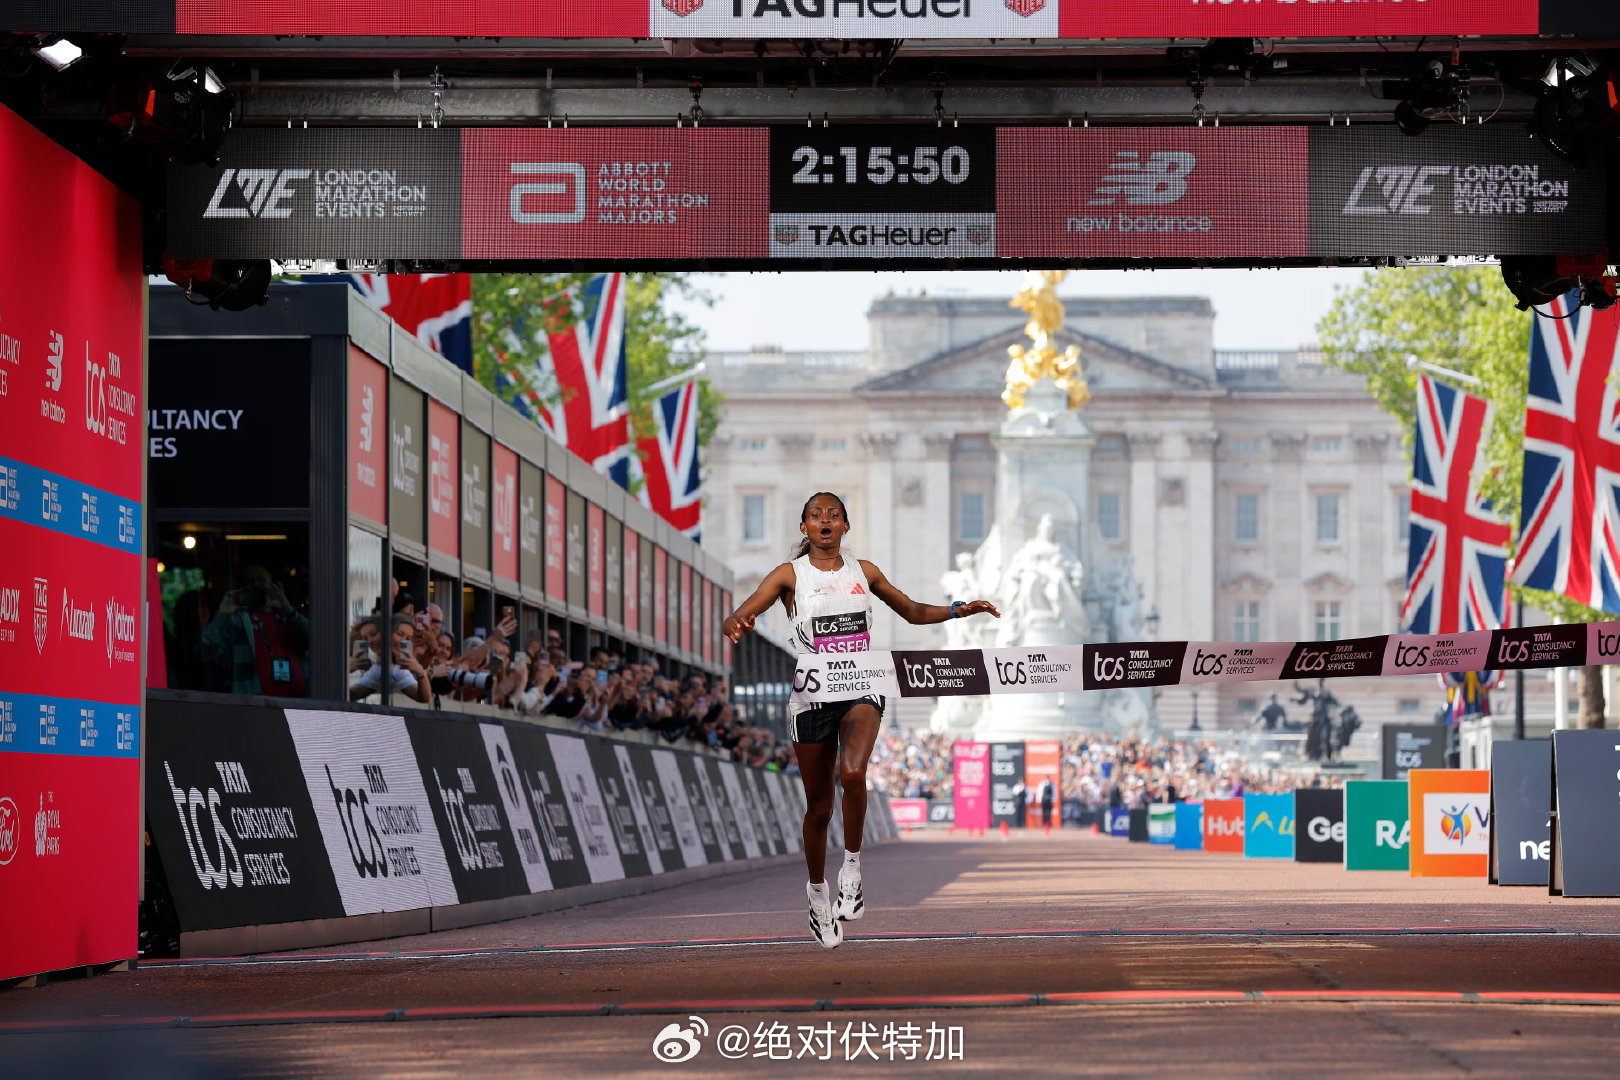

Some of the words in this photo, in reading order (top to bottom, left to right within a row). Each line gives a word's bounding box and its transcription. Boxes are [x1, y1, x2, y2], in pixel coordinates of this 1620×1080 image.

[599, 162, 672, 176] ABBOTT
[792, 146, 970, 184] 2:15:50
[316, 171, 397, 185] LONDON
[1454, 165, 1539, 181] LONDON
[599, 178, 666, 192] WORLD
[1454, 181, 1569, 197] MARATHON
[316, 186, 426, 202] MARATHON
[599, 193, 710, 208] MARATHON
[316, 203, 385, 217] EVENTS
[1454, 198, 1526, 213] EVENTS
[599, 210, 677, 224] MAJORS
[1067, 216, 1113, 232] new
[1118, 212, 1214, 233] balance
[808, 225, 957, 246] TAGHeuer
[109, 352, 121, 379] TATA
[86, 340, 106, 436] tcs
[148, 409, 244, 430] LTANCY
[815, 620, 838, 634] tcs
[1534, 633, 1553, 642] TATA
[1433, 647, 1478, 658] CONSULTANCY
[1498, 635, 1530, 663] tcs
[1533, 641, 1576, 652] CONSULTANCY
[933, 657, 952, 666] TATA
[1028, 654, 1047, 662] TATA
[1130, 650, 1150, 659] TATA
[1193, 648, 1228, 675] tcs
[1229, 657, 1275, 665] CONSULTANCY
[1295, 648, 1330, 672] tcs
[1330, 652, 1374, 661] CONSULTANCY
[1395, 641, 1431, 668] tcs
[1531, 651, 1560, 661] SERVICES
[827, 660, 857, 670] TATA
[1029, 664, 1072, 673] CONSULTANCY
[1094, 651, 1125, 681] tcs
[1128, 658, 1174, 669] CONSULTANCY
[1326, 661, 1355, 671] SERVICES
[1429, 657, 1459, 667] SERVICES
[827, 669, 886, 682] CONSULTANCY
[903, 658, 936, 688] tcs
[936, 667, 976, 677] CONSULTANCY
[995, 656, 1027, 685] tcs
[1127, 670, 1156, 680] SERVICES
[1226, 666, 1256, 675] SERVICES
[938, 679, 965, 688] SERVICES
[1030, 675, 1058, 684] SERVICES
[828, 681, 871, 693] SERVICES
[215, 762, 251, 793] TATA
[363, 764, 389, 794] TATA
[164, 761, 243, 889] tcs
[231, 807, 298, 840] CONSULTANCY
[325, 764, 388, 879] tcs
[376, 805, 423, 836] CONSULTANCY
[387, 846, 420, 877] SERVICES
[244, 853, 291, 885] SERVICES
